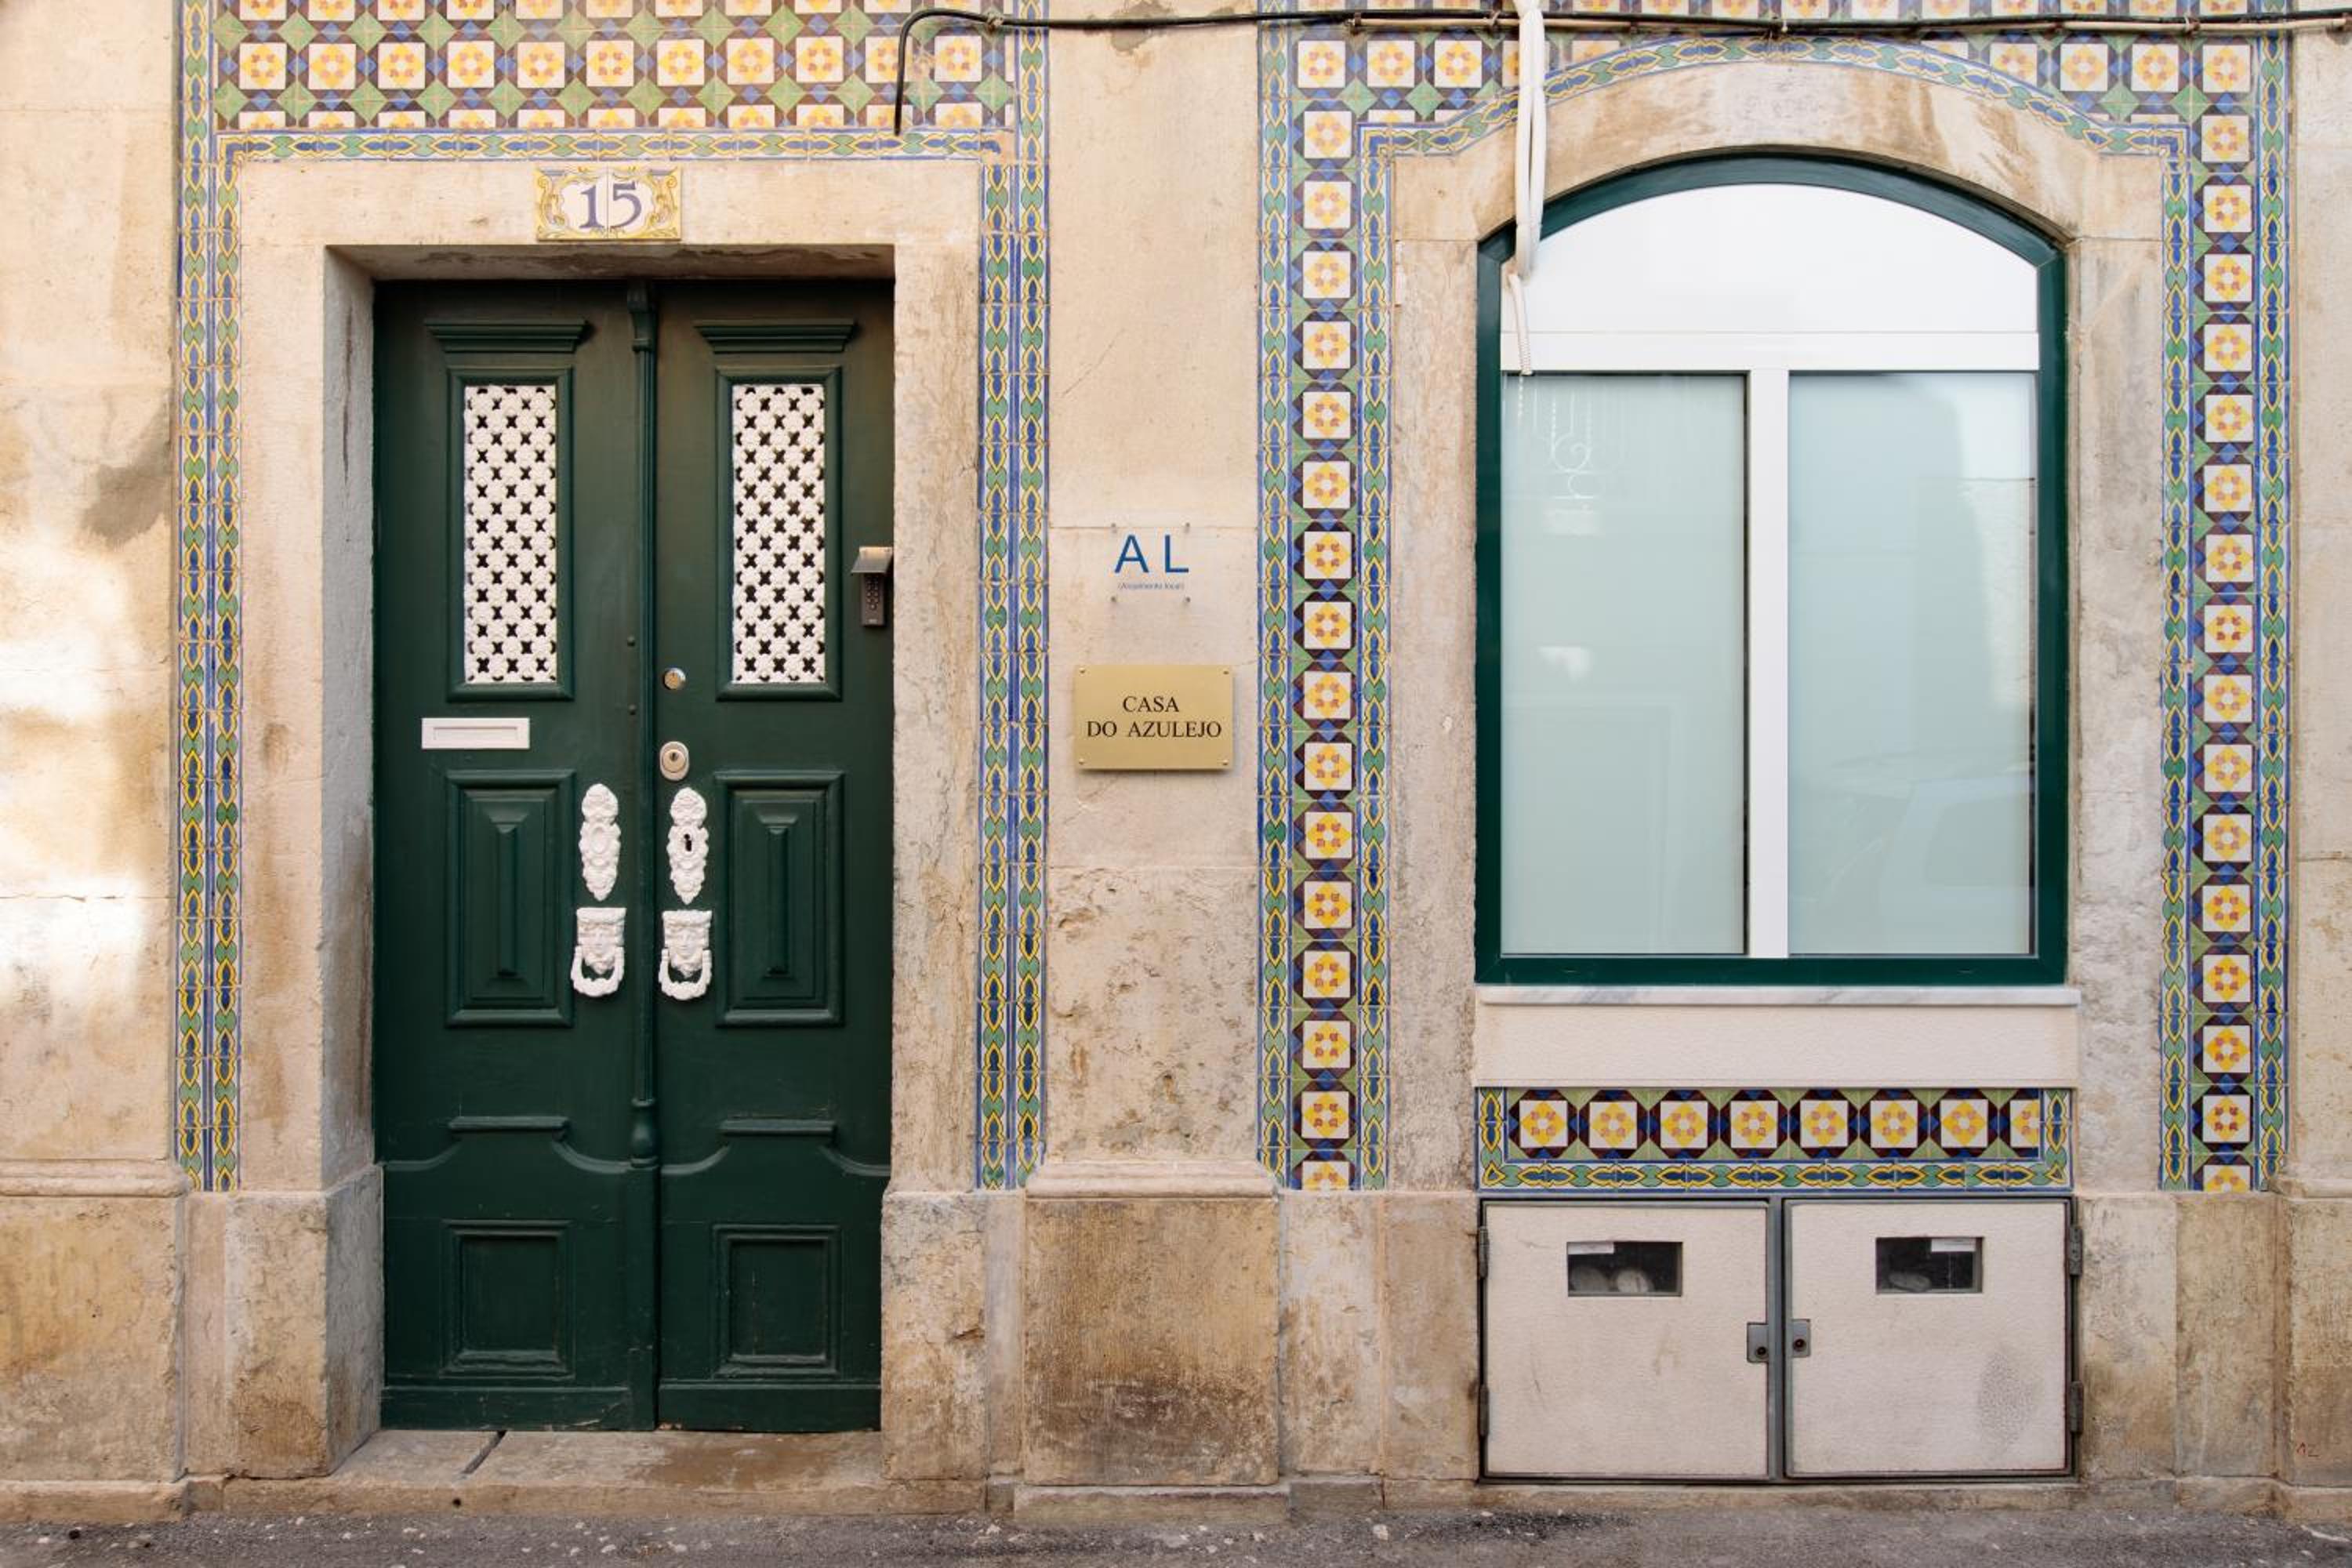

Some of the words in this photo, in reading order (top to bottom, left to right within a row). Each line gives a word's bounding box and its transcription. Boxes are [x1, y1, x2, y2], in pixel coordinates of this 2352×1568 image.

[579, 181, 642, 229] 15
[1123, 695, 1180, 713] CASA
[1087, 720, 1117, 737] DO
[1127, 720, 1221, 738] AZULEJO
